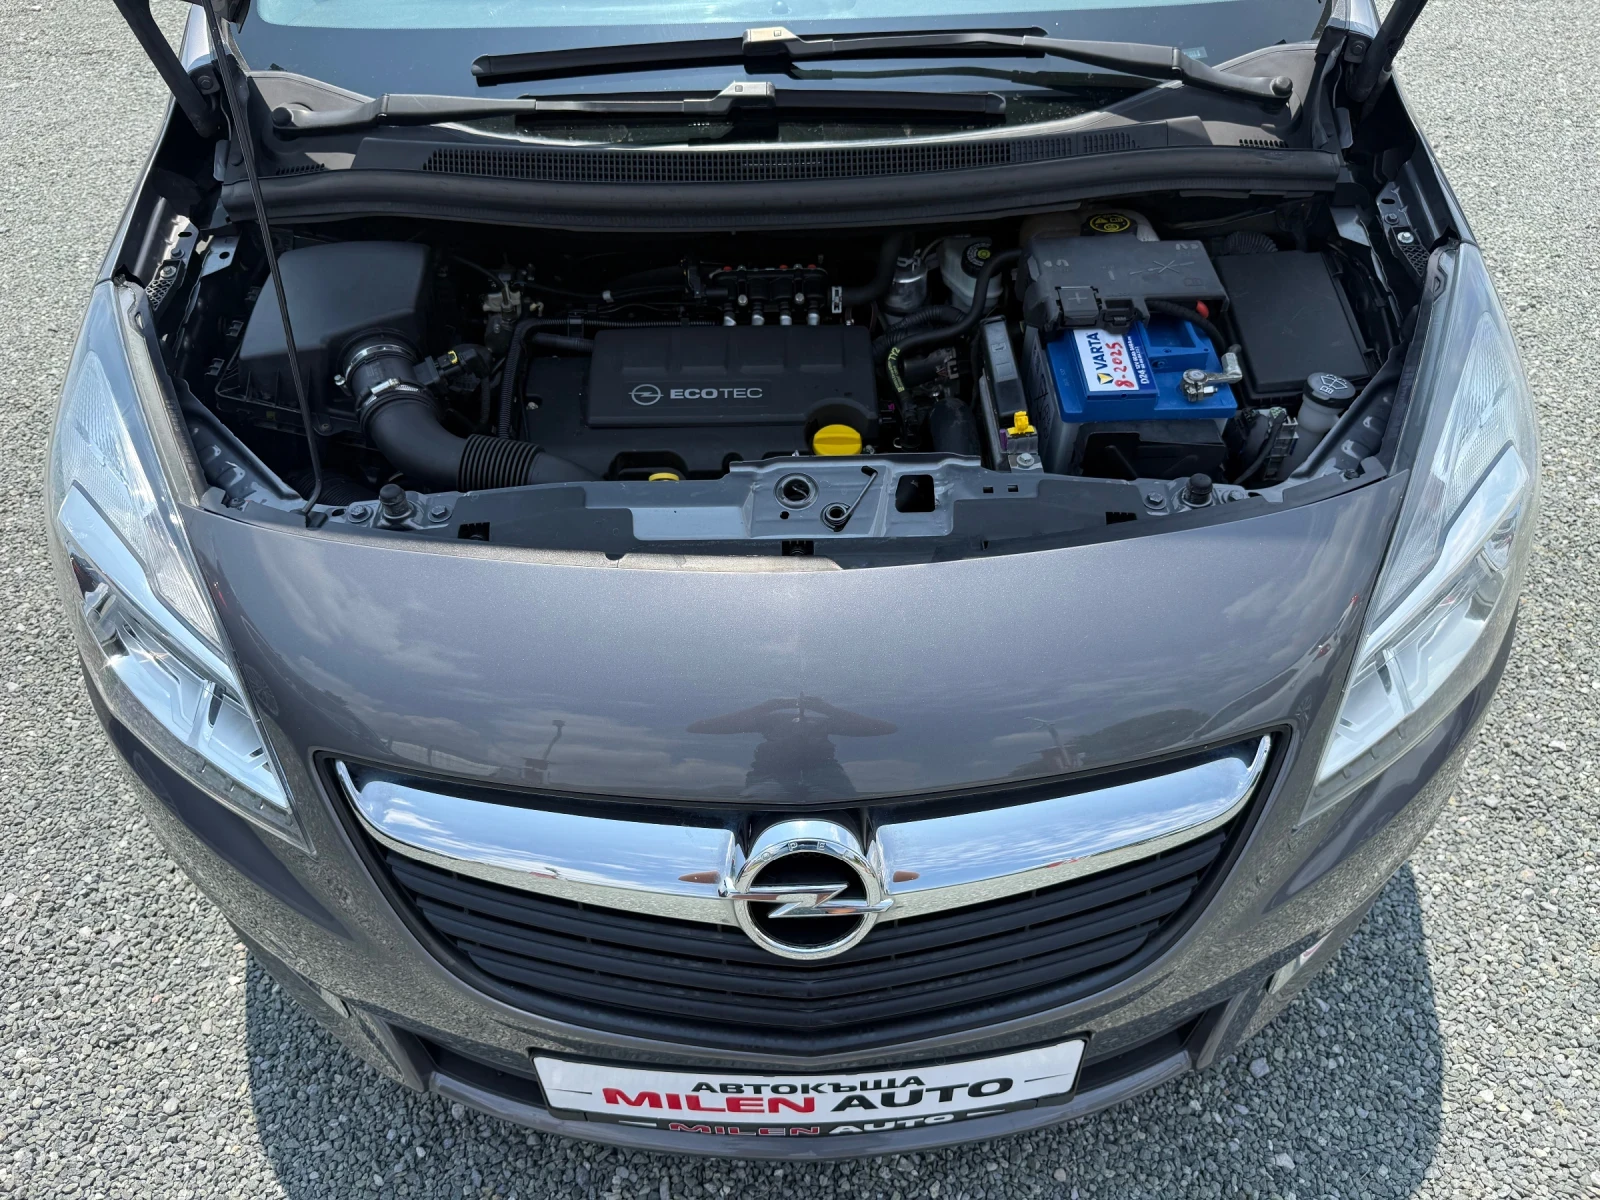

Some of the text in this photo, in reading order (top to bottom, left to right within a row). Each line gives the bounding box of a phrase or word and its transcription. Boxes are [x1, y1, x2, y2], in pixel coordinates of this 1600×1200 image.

[1086, 331, 1108, 370] VARTA
[1105, 341, 1135, 388] 8-2025
[1138, 369, 1150, 385] D24
[670, 388, 763, 399] ECOTEC
[602, 1077, 1013, 1114] MILEN AUTO
[668, 1113, 955, 1136] MILEN AUTO
